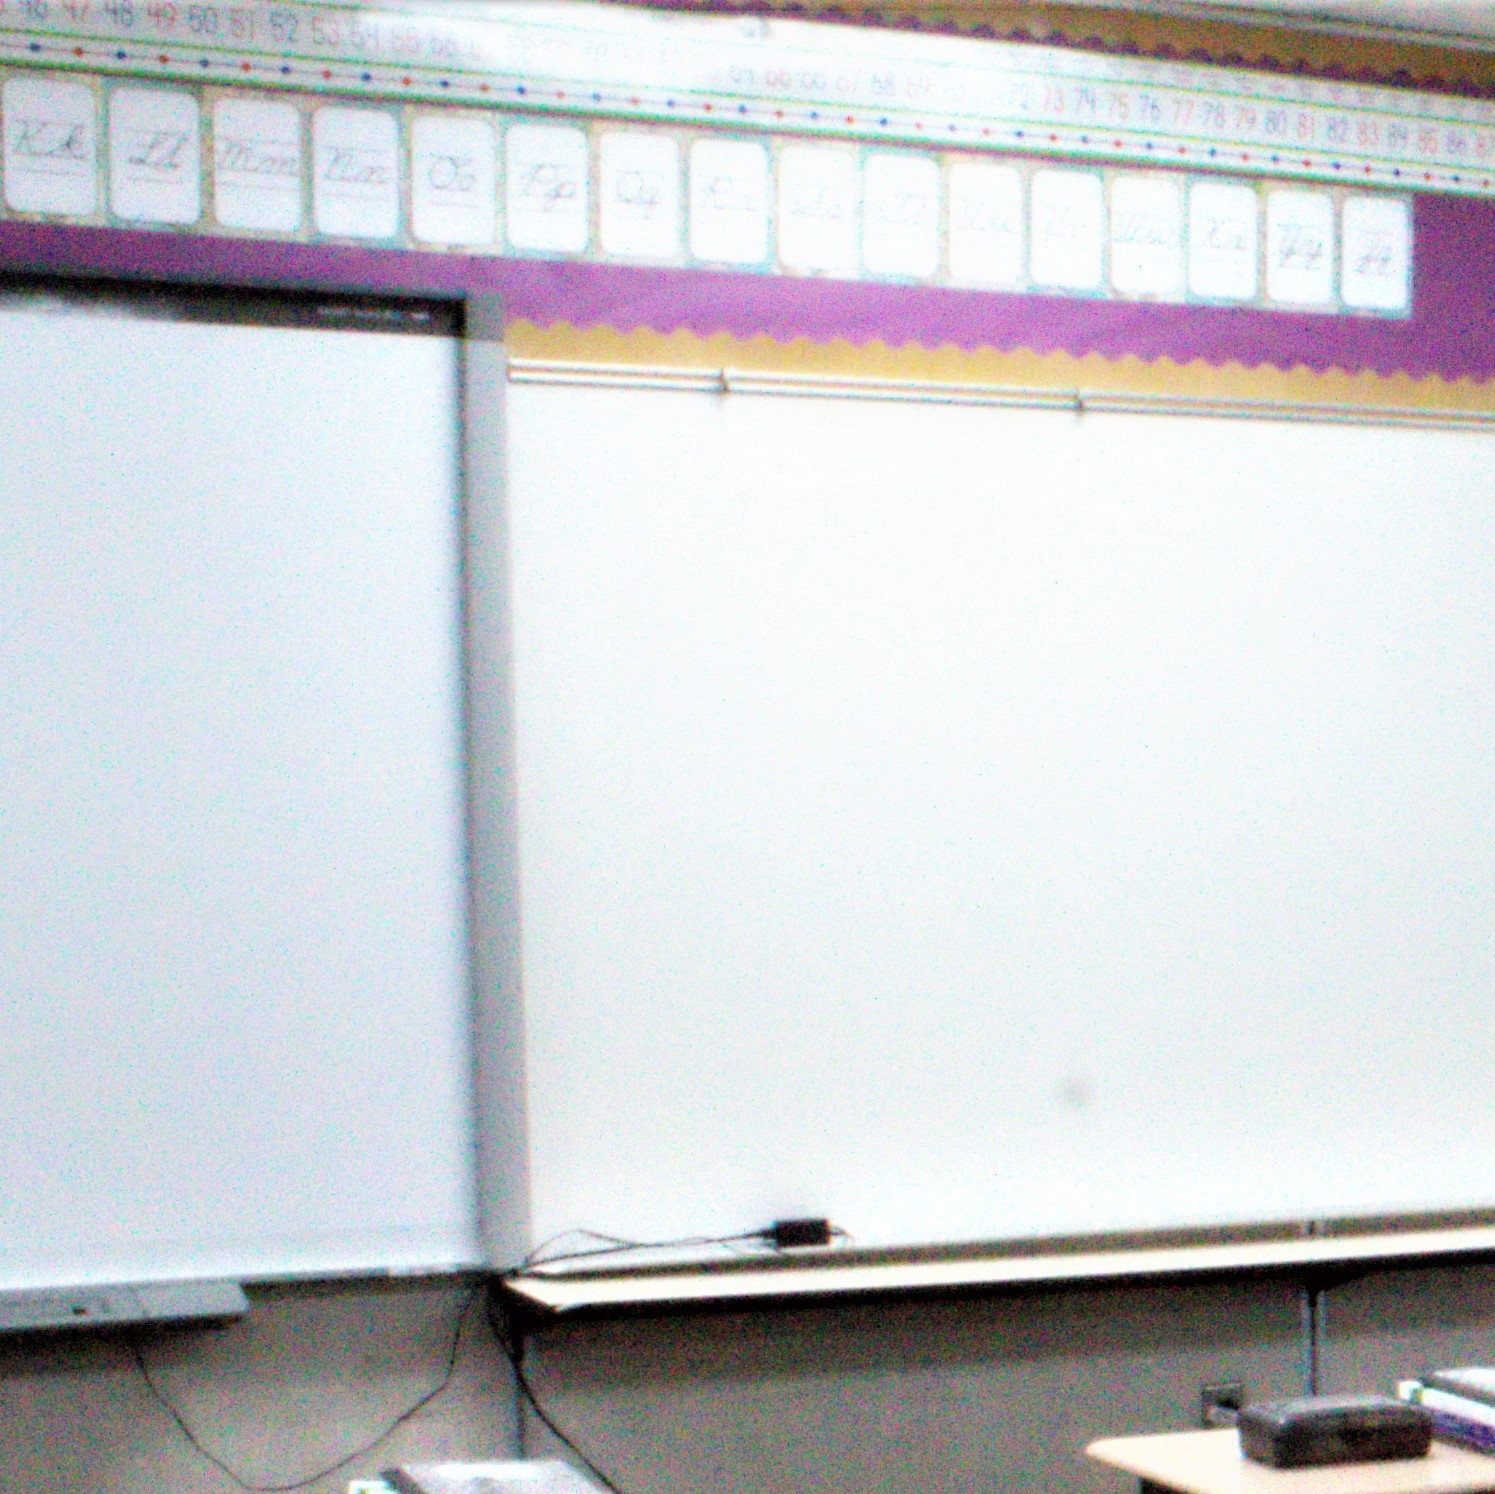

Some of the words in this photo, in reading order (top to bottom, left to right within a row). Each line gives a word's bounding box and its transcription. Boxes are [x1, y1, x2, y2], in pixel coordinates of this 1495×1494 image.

[104, 2, 135, 28] 48
[146, 2, 178, 32] 49
[187, 5, 219, 34] 50
[229, 8, 256, 39] 51
[269, 11, 299, 43] 52
[1042, 86, 1065, 115] 73
[1074, 86, 1098, 116] 74
[1108, 91, 1132, 121] 75
[1138, 92, 1162, 123] 76
[1172, 96, 1195, 126] 77
[1202, 99, 1226, 129] 78
